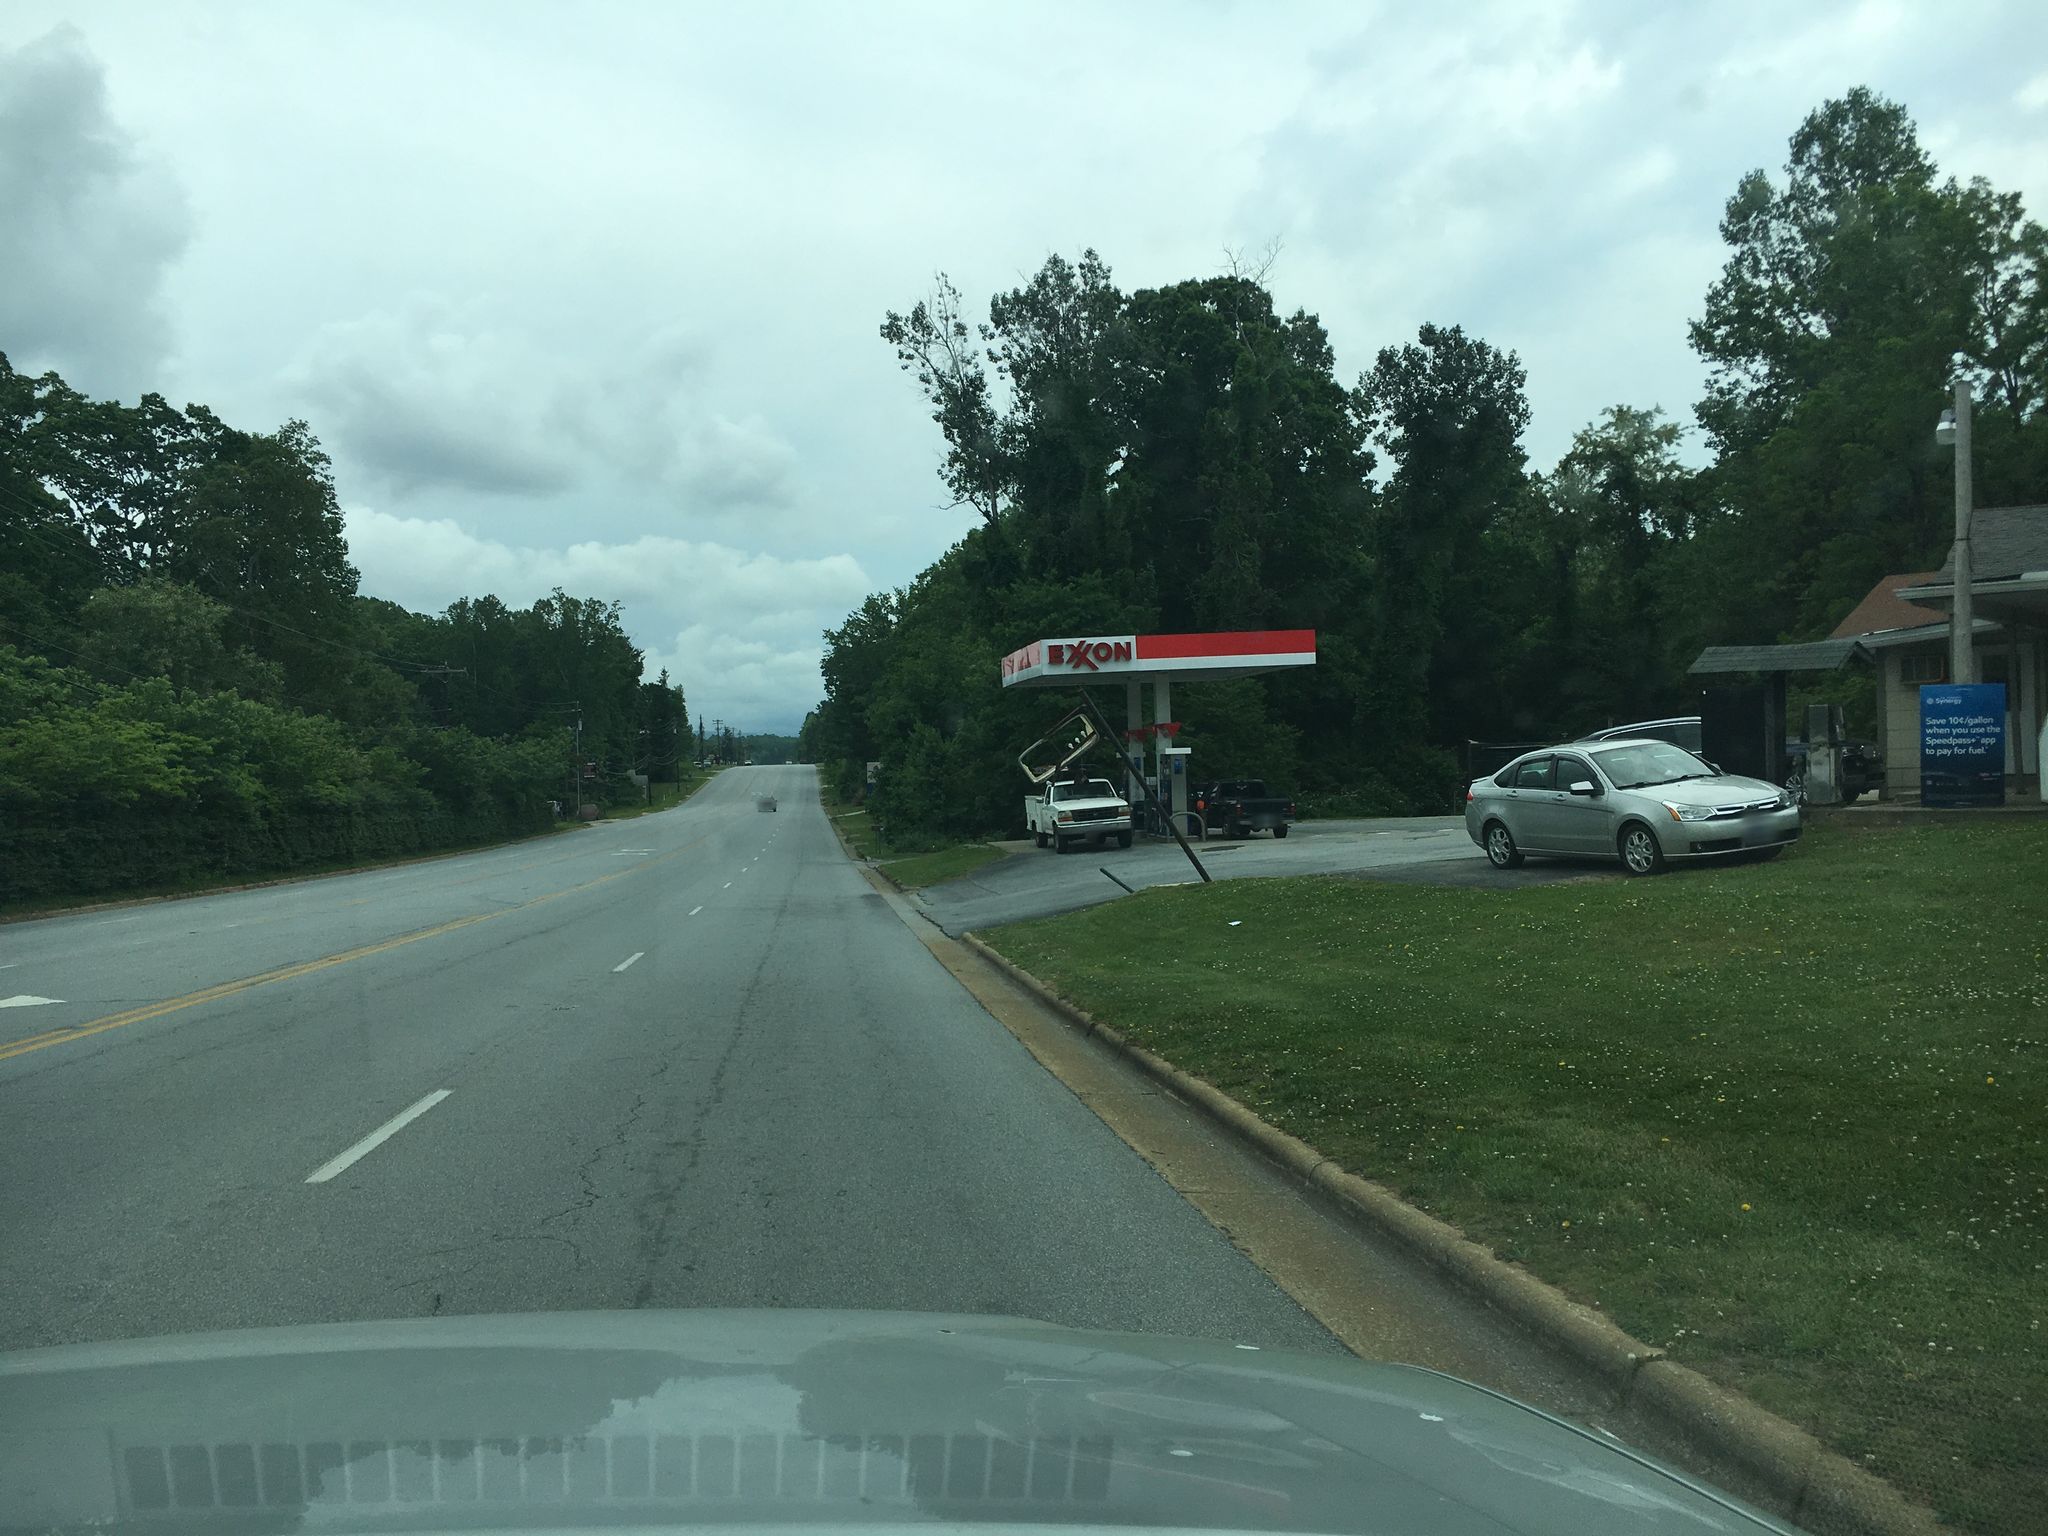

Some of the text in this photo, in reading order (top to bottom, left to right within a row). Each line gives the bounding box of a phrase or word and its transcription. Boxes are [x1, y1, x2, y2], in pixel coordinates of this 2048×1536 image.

[1048, 640, 1131, 670] EXXON
[1949, 716, 1993, 726] 10¢/gallon
[1926, 726, 1950, 734] when
[1952, 728, 1969, 736] you
[1986, 725, 2001, 733] the
[1980, 737, 1996, 746] app
[1937, 748, 1953, 757] pay
[1954, 746, 1967, 755] for
